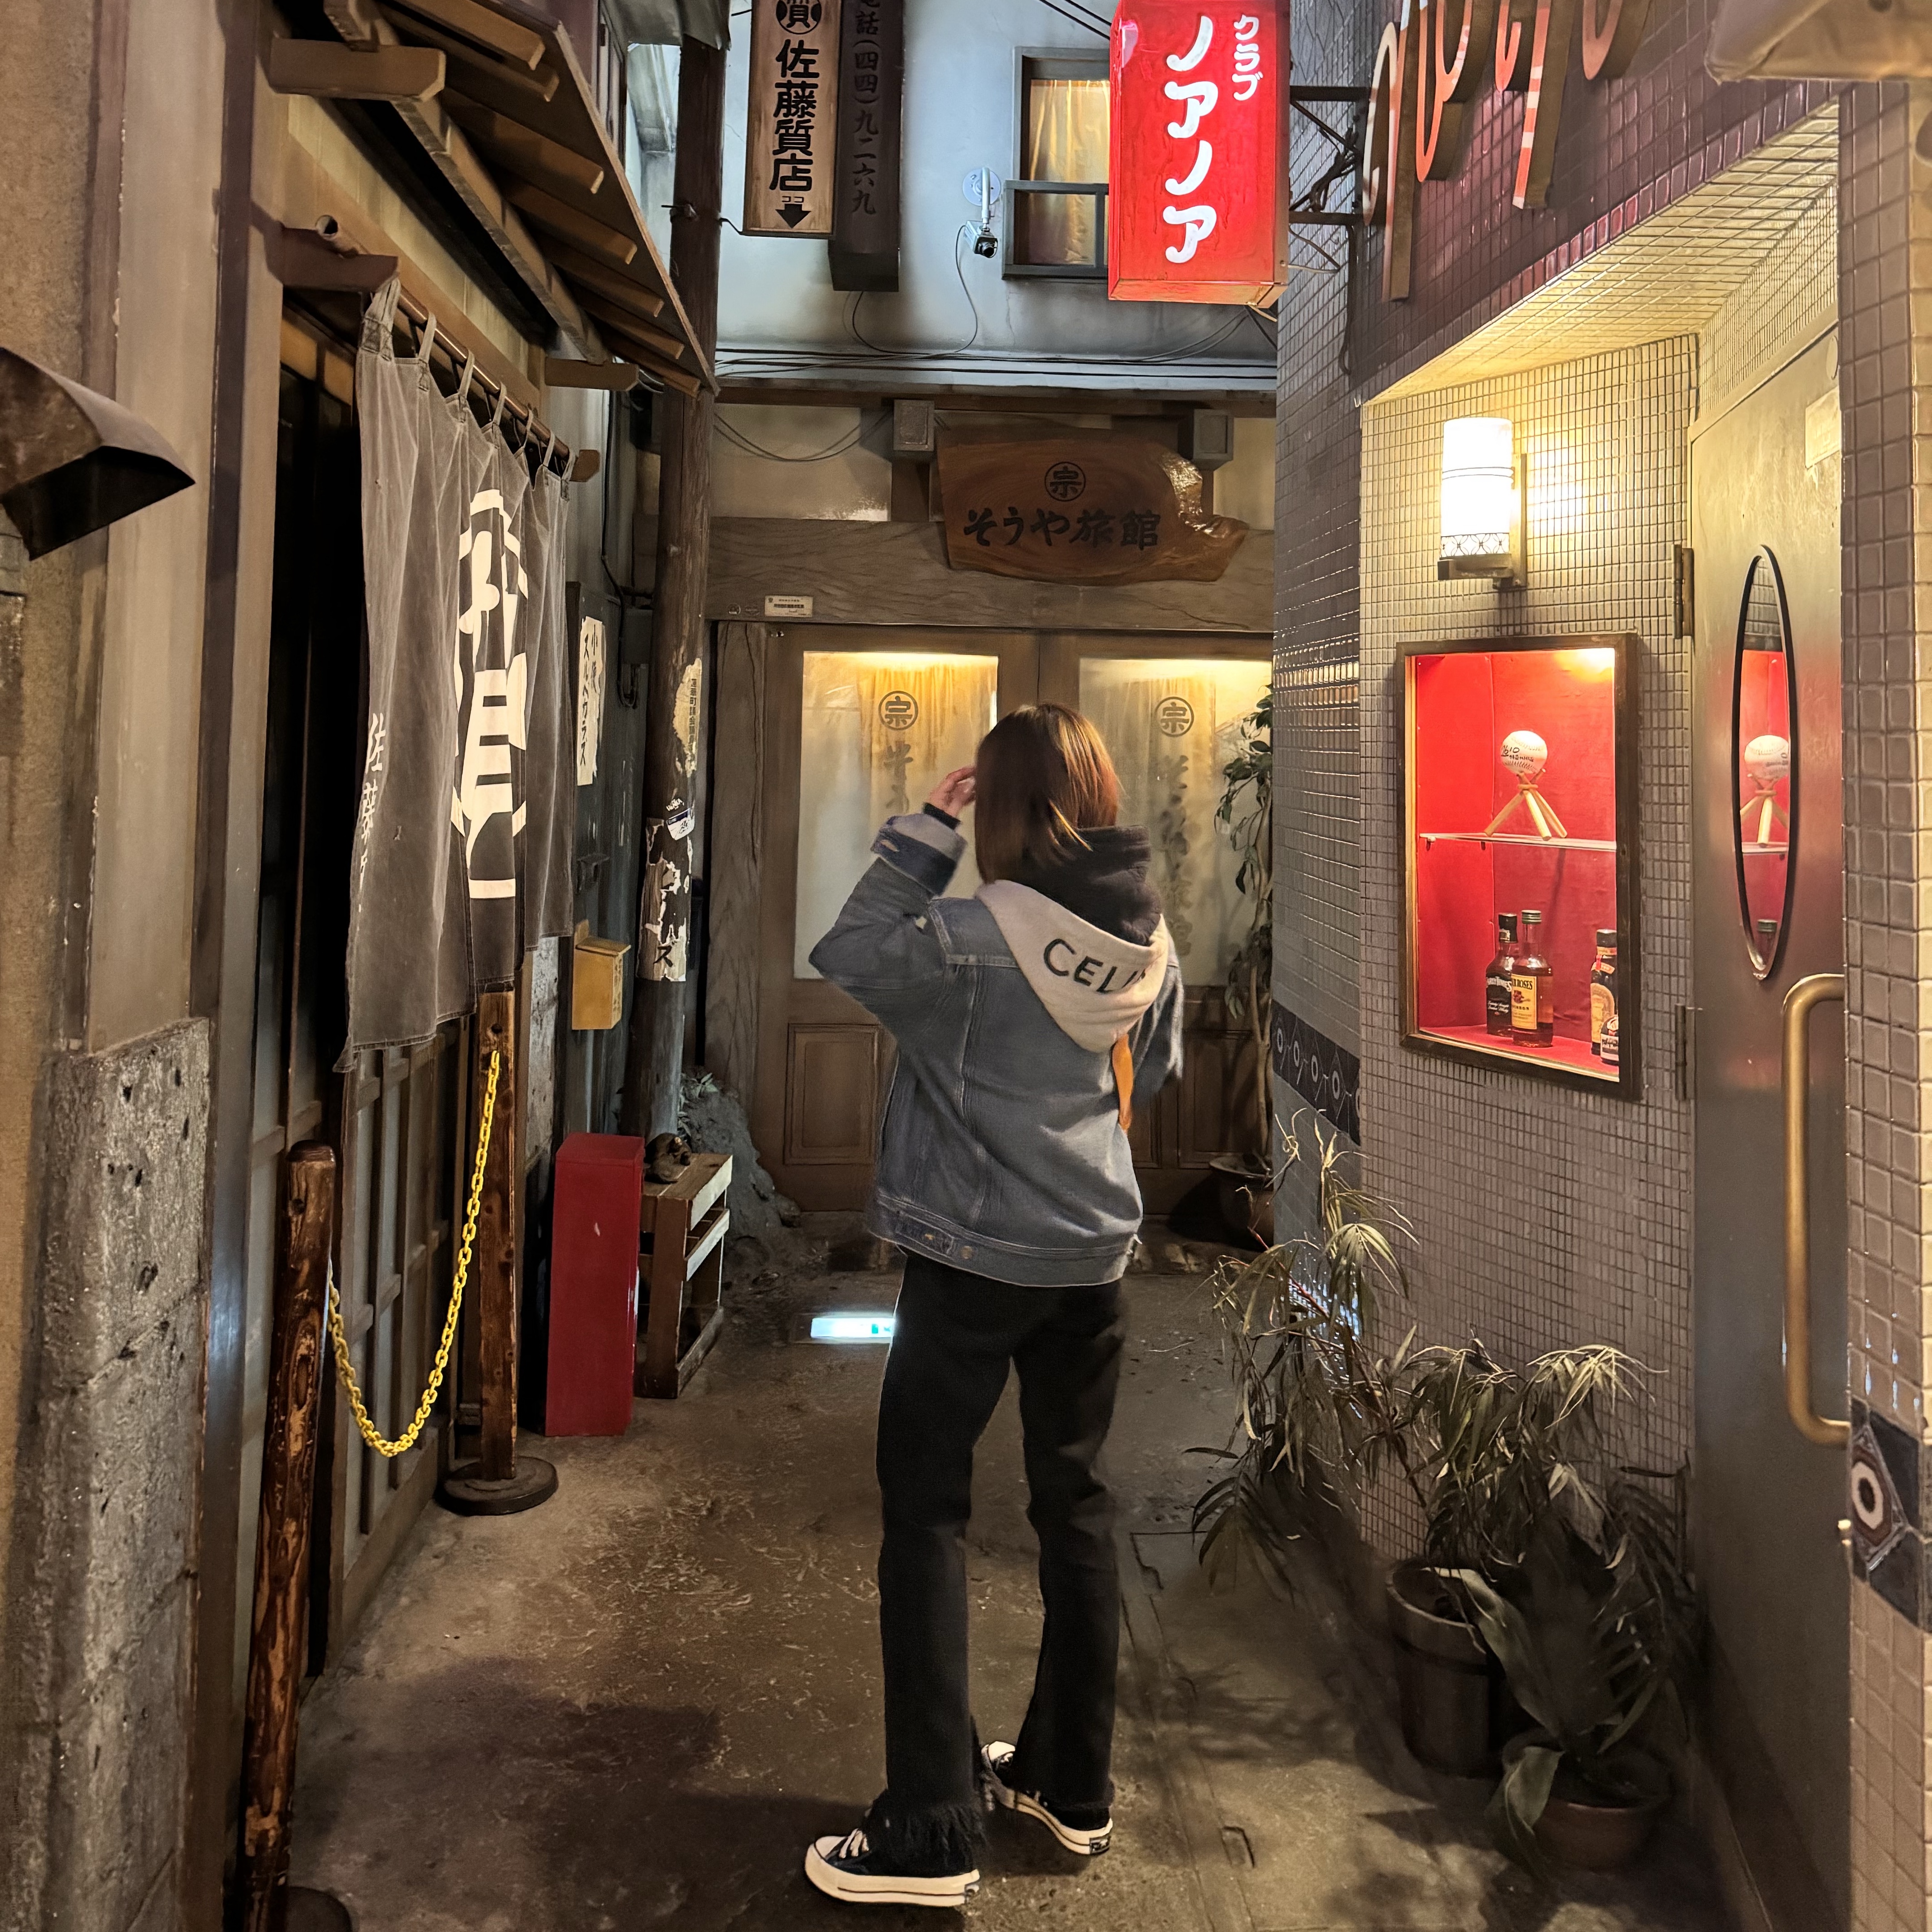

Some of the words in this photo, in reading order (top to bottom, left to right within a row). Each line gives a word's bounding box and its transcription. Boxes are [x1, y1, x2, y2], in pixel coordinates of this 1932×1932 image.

[1232, 14, 1263, 101] クラブ
[769, 39, 820, 192] 佐藤質店
[1162, 16, 1218, 263] ノアノア
[1048, 464, 1084, 500] 宗
[963, 506, 1161, 551] そうや旅館
[883, 694, 915, 728] 宗
[1158, 699, 1192, 735] 宗
